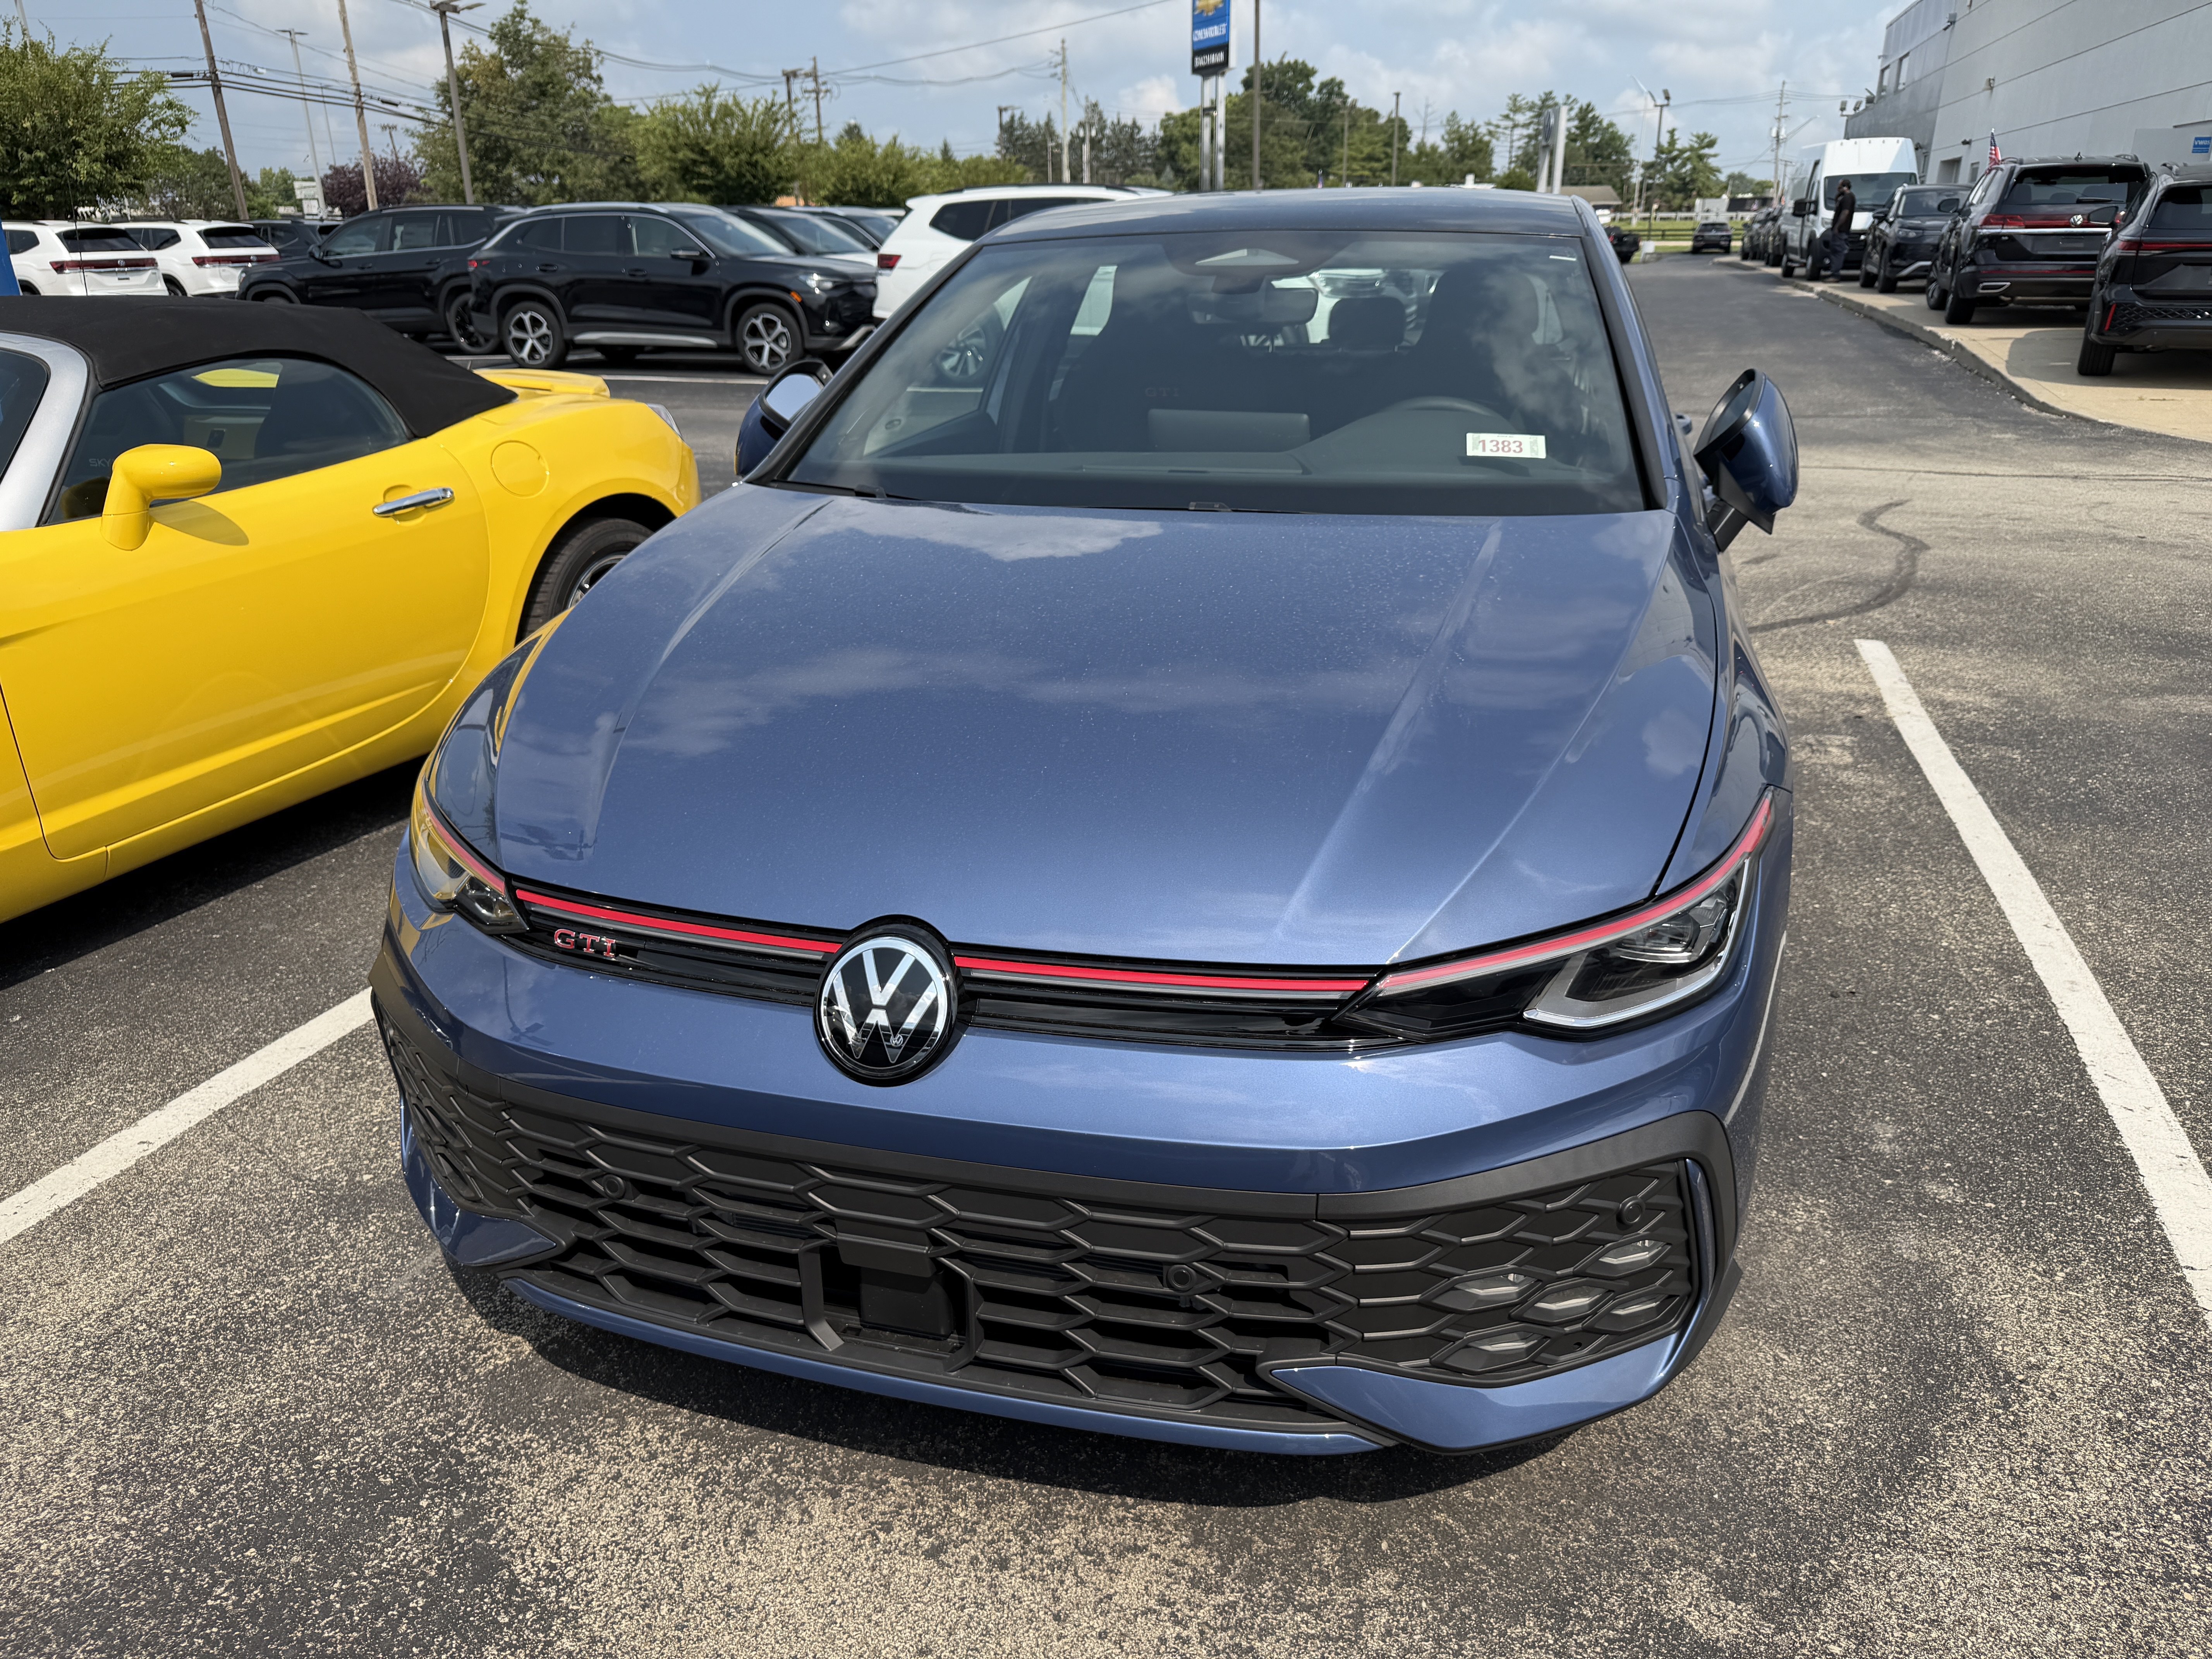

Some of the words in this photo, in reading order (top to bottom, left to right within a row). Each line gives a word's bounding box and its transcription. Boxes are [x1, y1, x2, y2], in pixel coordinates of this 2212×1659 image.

[1145, 387, 1179, 397] GTI
[1479, 440, 1523, 453] 1383
[554, 929, 616, 958] GTI
[831, 945, 939, 1065] VW
